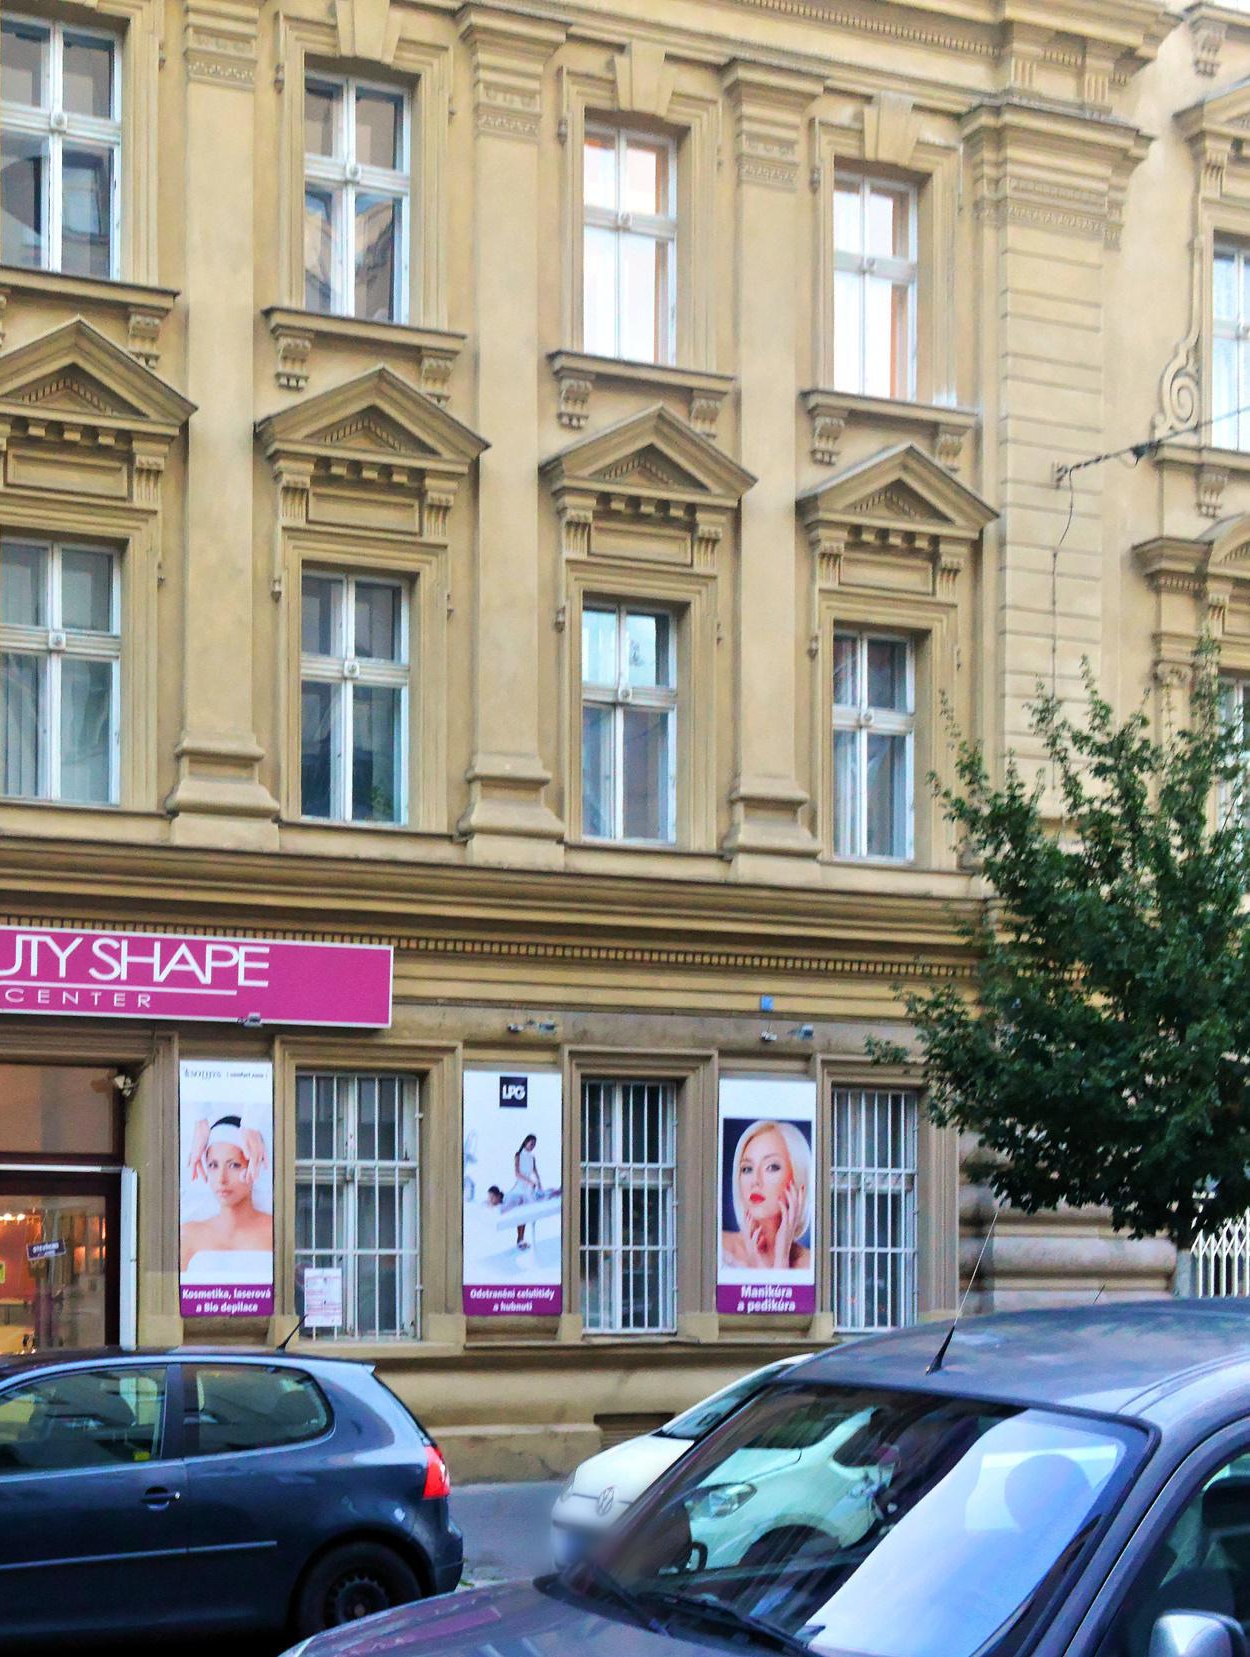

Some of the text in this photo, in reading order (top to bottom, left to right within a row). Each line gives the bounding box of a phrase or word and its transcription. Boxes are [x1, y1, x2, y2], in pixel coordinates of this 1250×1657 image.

[89, 937, 270, 987] SHAPE
[5, 988, 151, 1009] CENTER
[502, 1084, 526, 1101] LPG
[182, 1288, 271, 1300] Kosmetika, laserová
[741, 1284, 793, 1298] Manikúra
[195, 1302, 259, 1314] a Bio depilace
[492, 1303, 500, 1312] a
[737, 1298, 796, 1314] a pedikúra
